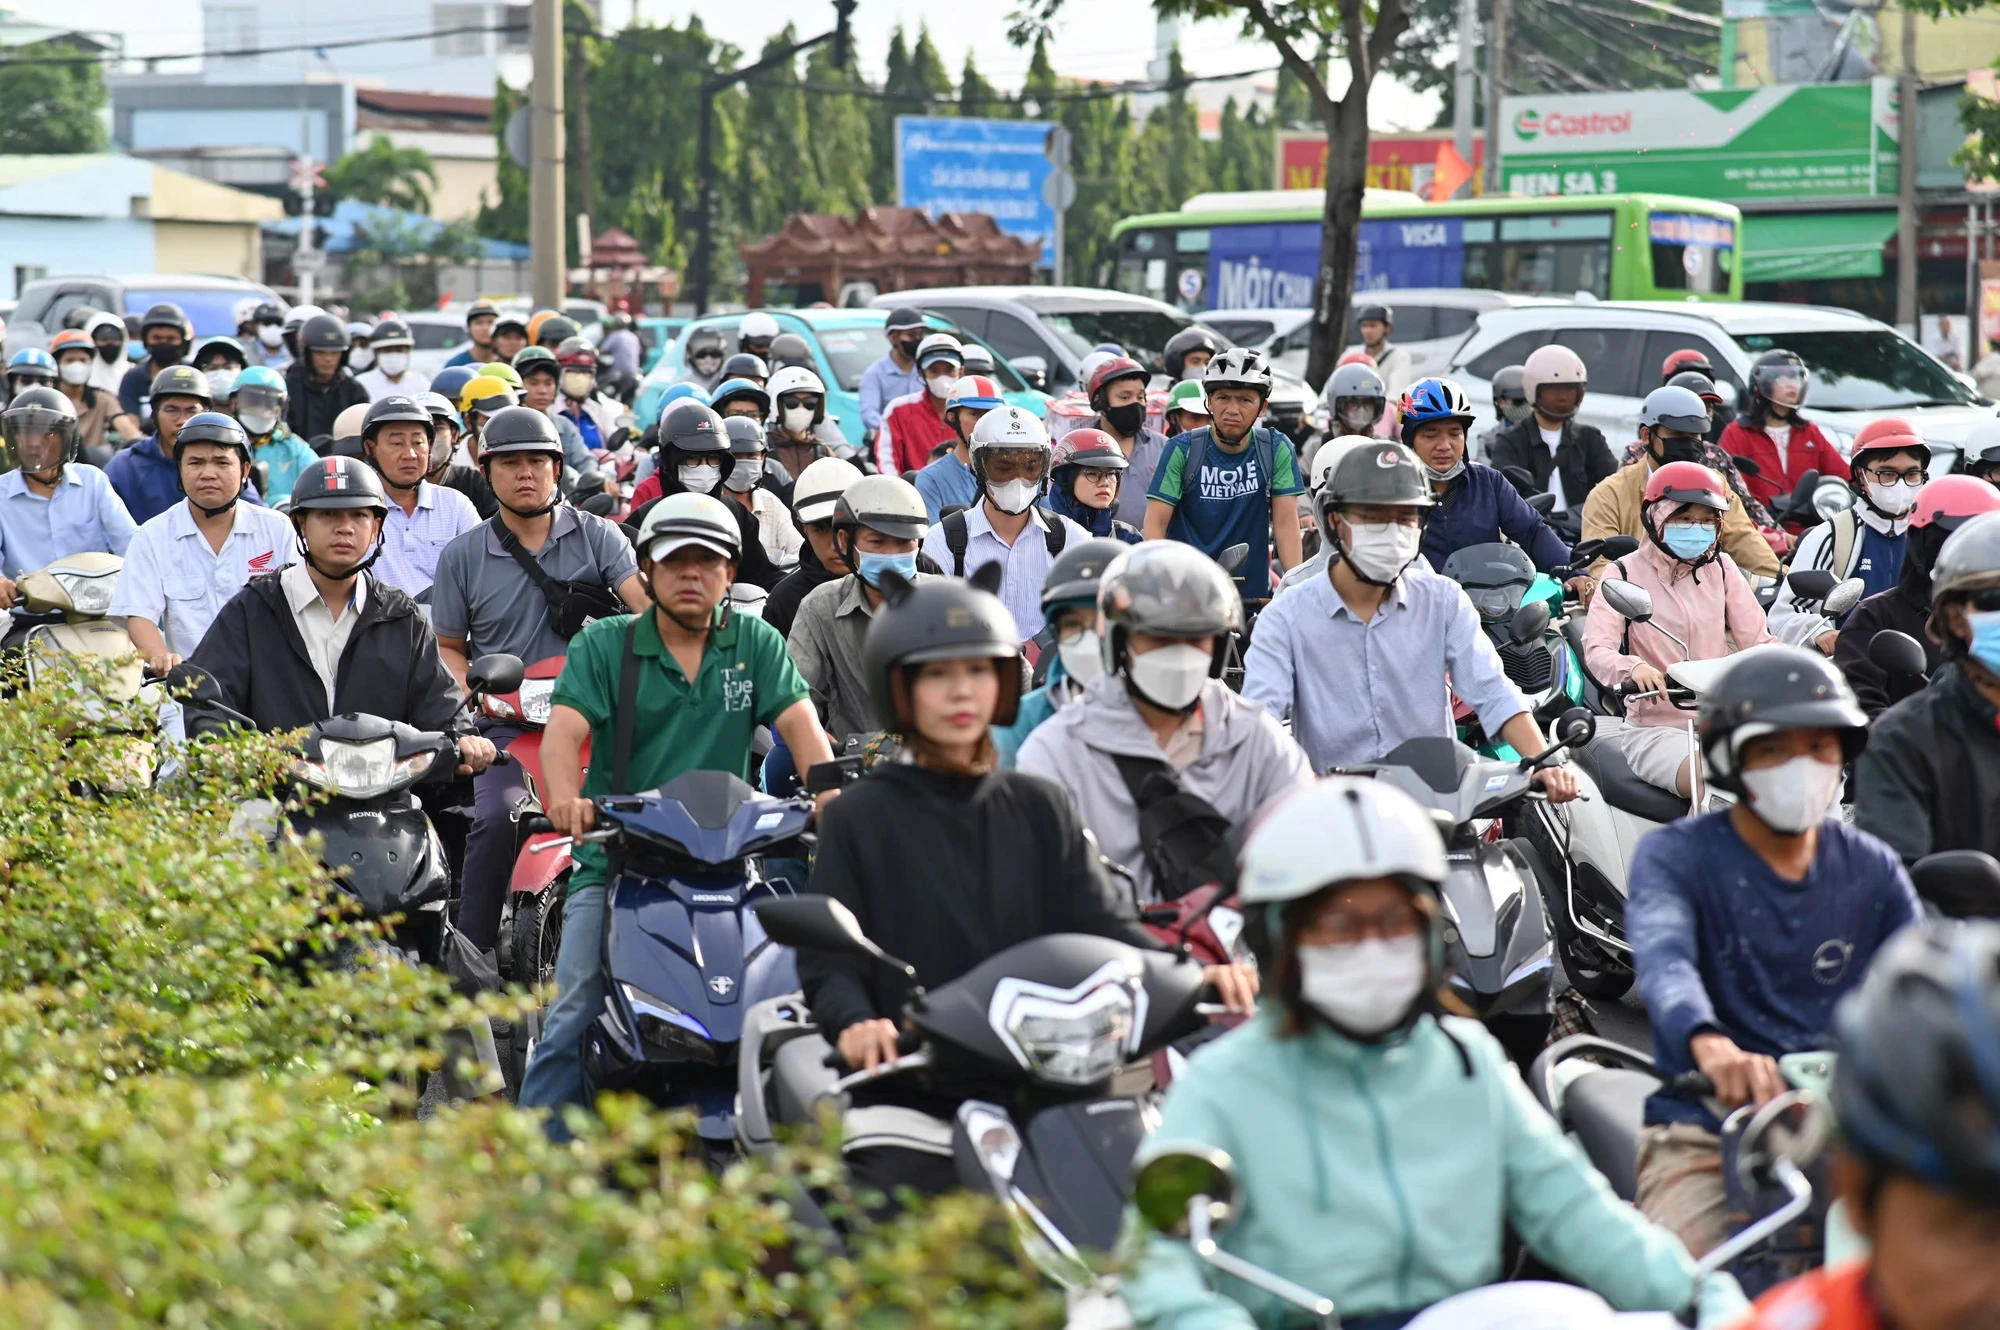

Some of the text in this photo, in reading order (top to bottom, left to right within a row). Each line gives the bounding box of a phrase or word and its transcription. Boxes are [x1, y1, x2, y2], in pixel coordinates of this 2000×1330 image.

[1544, 110, 1632, 135] Castrol
[1563, 171, 1598, 194] SA
[1601, 170, 1617, 194] 3
[1401, 224, 1447, 247] VISA
[1201, 478, 1259, 497] VIETNAM
[692, 894, 734, 902] HONDA
